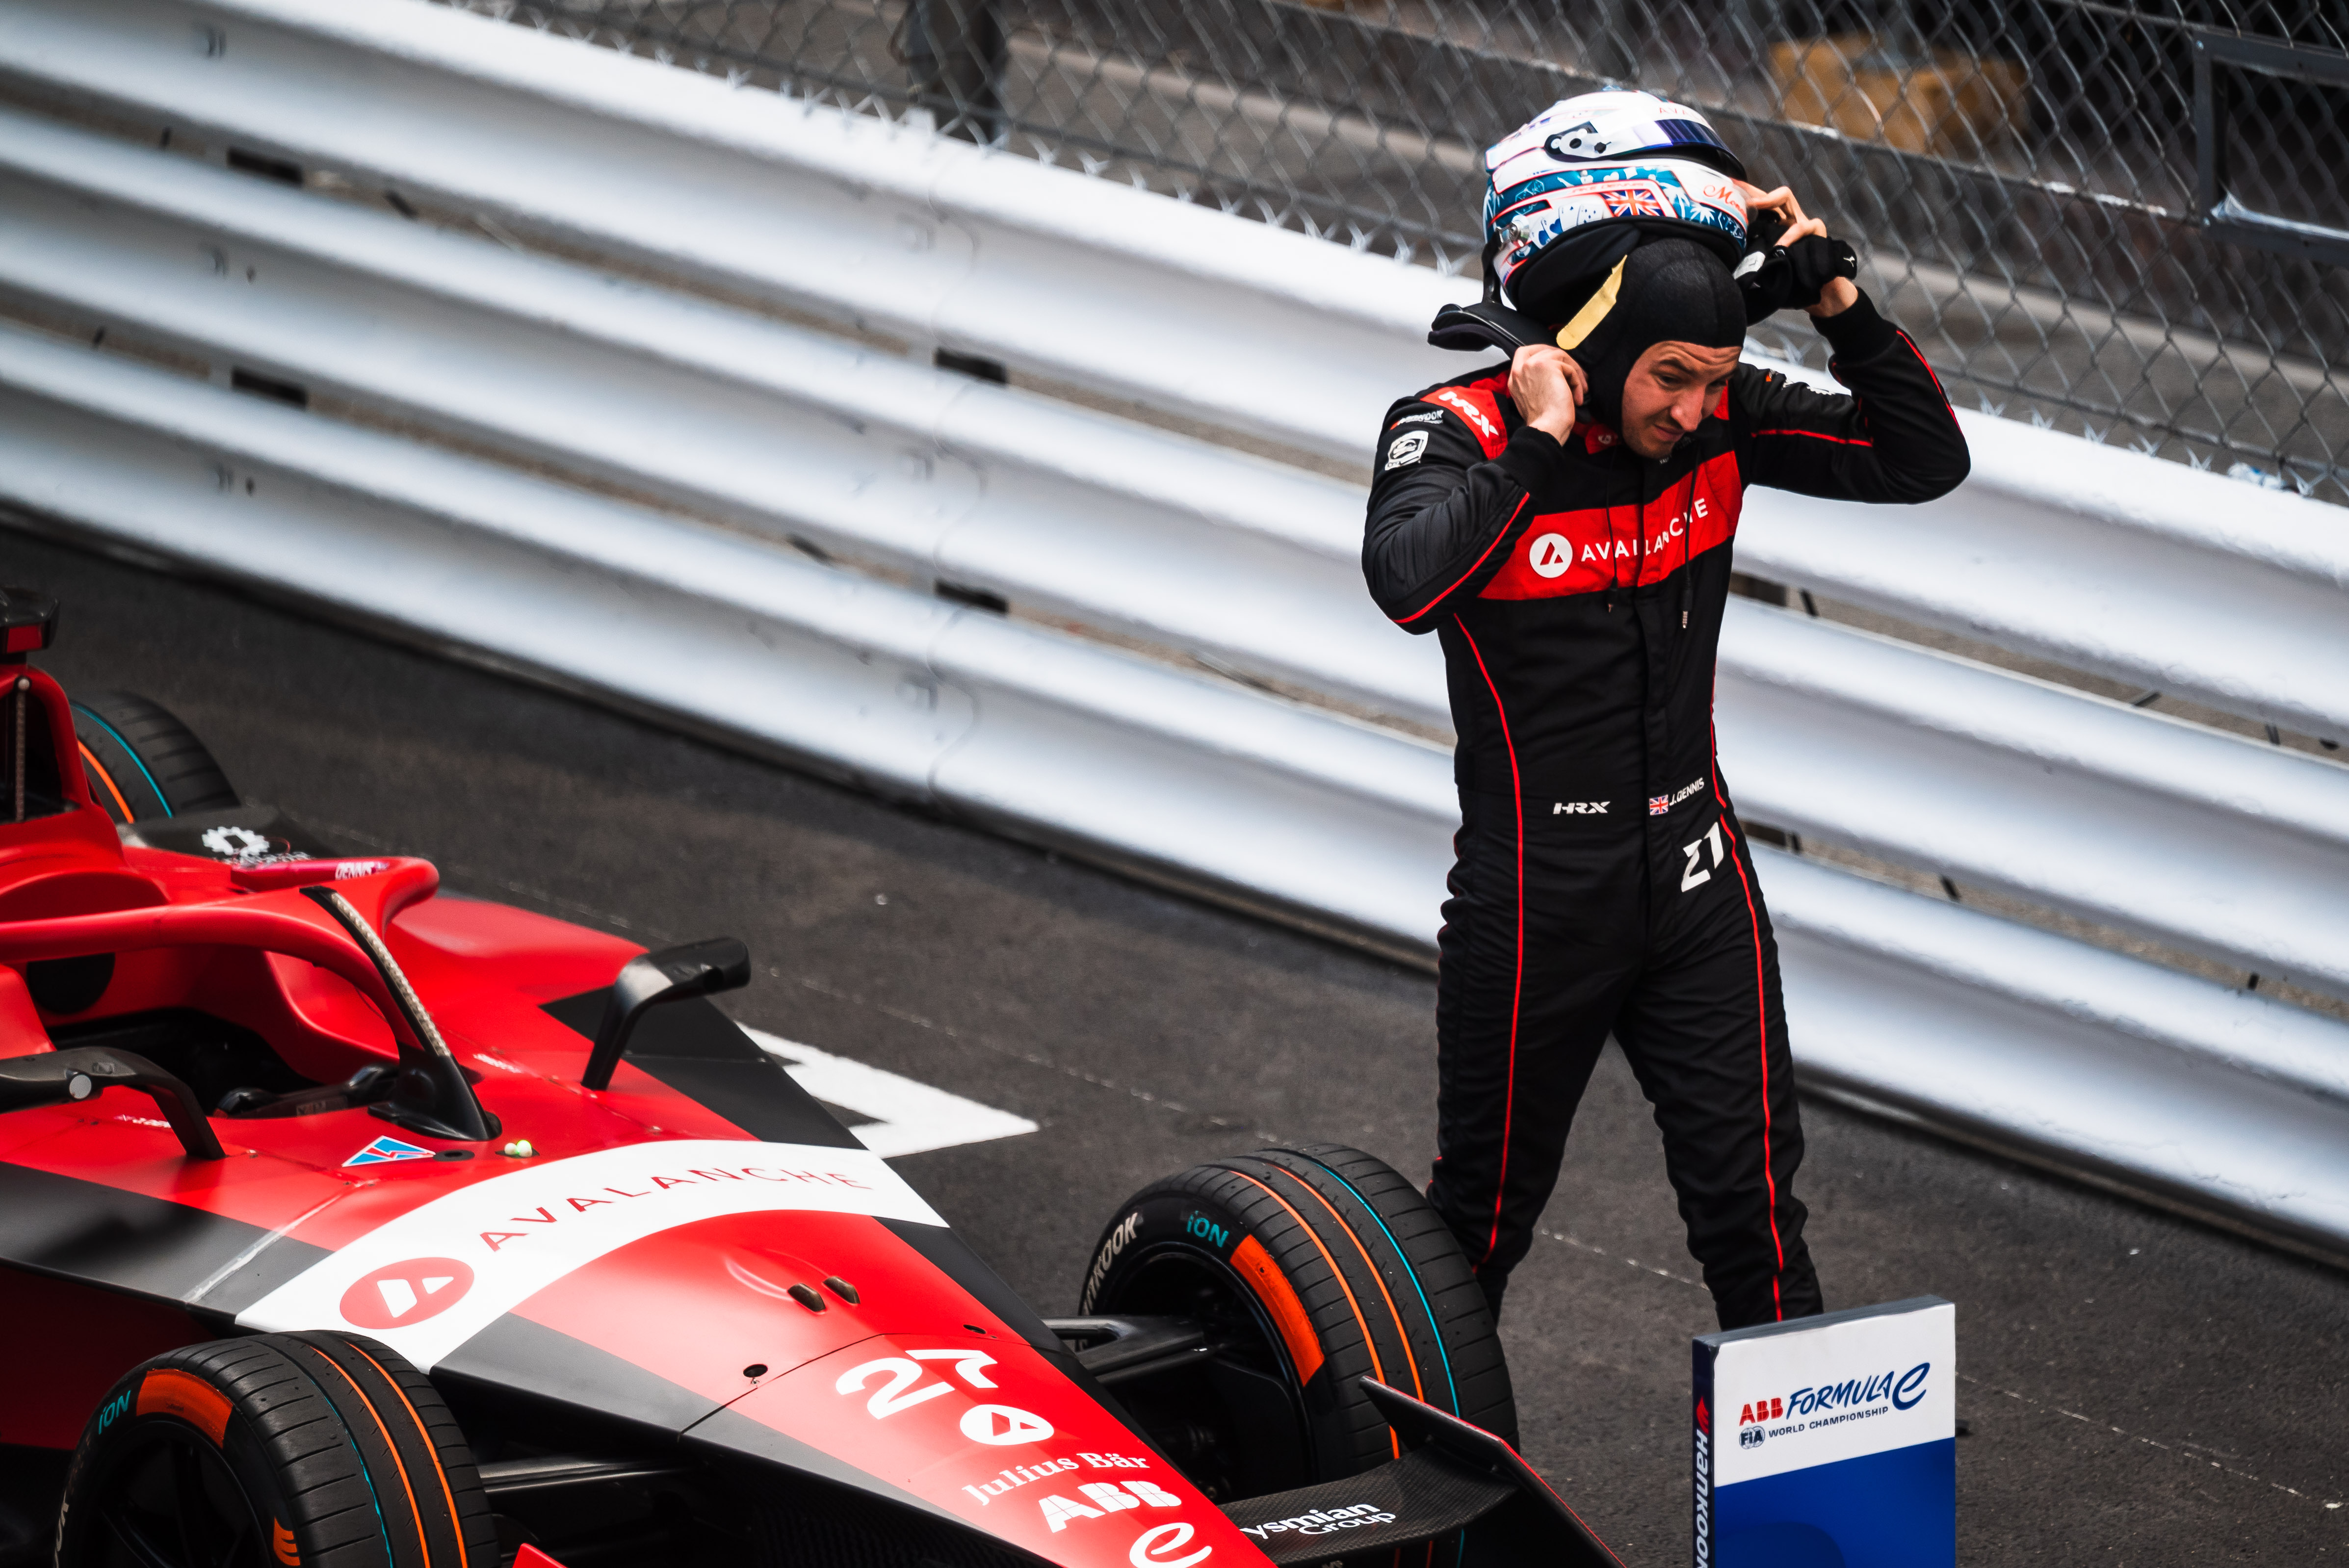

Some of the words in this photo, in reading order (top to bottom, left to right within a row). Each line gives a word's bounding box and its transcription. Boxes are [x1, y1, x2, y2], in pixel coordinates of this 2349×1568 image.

[1438, 391, 1499, 438] HRX
[1553, 801, 1611, 815] HRX
[479, 1168, 873, 1253] AVALANCHE
[835, 1349, 998, 1420] 27
[1739, 1397, 1783, 1426] ABB
[1786, 1371, 1895, 1420] FORMULA
[1768, 1424, 1805, 1438] WORLD
[1809, 1406, 1888, 1429] CHAMPIONSHIP
[962, 1455, 1080, 1506] Julius
[1076, 1452, 1150, 1469] Bär
[1038, 1480, 1182, 1534] ABB
[1239, 1504, 1381, 1540] ysmian
[1298, 1512, 1396, 1535] Group
